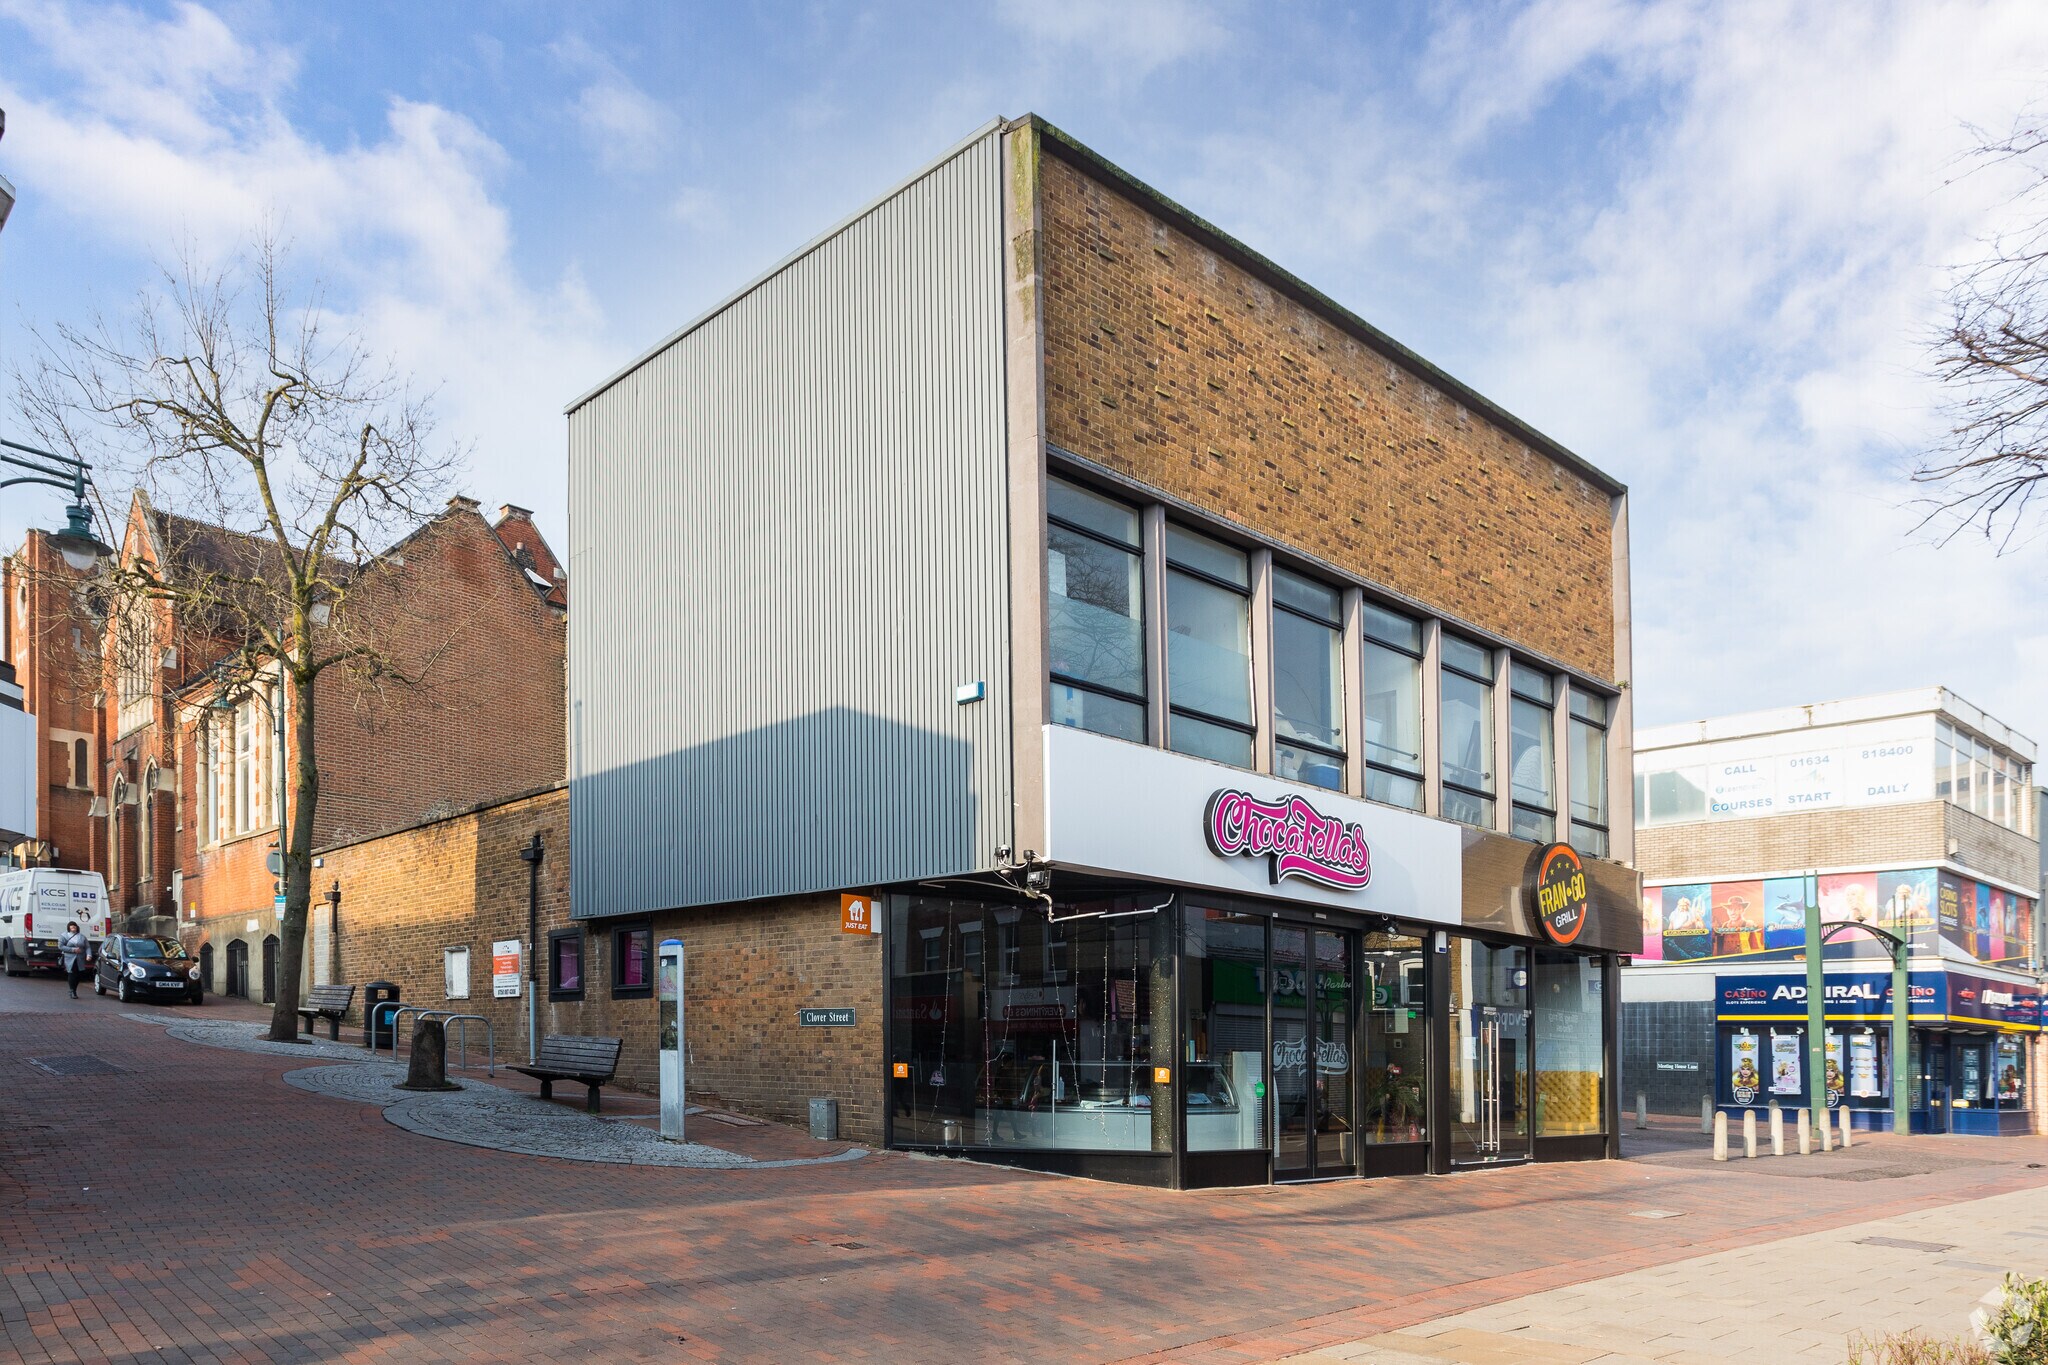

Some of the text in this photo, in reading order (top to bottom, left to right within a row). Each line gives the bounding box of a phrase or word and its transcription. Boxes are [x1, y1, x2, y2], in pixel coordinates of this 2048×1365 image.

[1724, 746, 1914, 775] CALL 01634 818400
[1711, 783, 1910, 812] COURSES START DAILY
[41, 888, 66, 897] KCS
[1555, 909, 1578, 928] GRILL
[1724, 990, 1767, 998] CASINO
[1772, 983, 1880, 1000] ADIRAL
[1885, 987, 1936, 997] CINO
[806, 1011, 849, 1022] Clover Street
